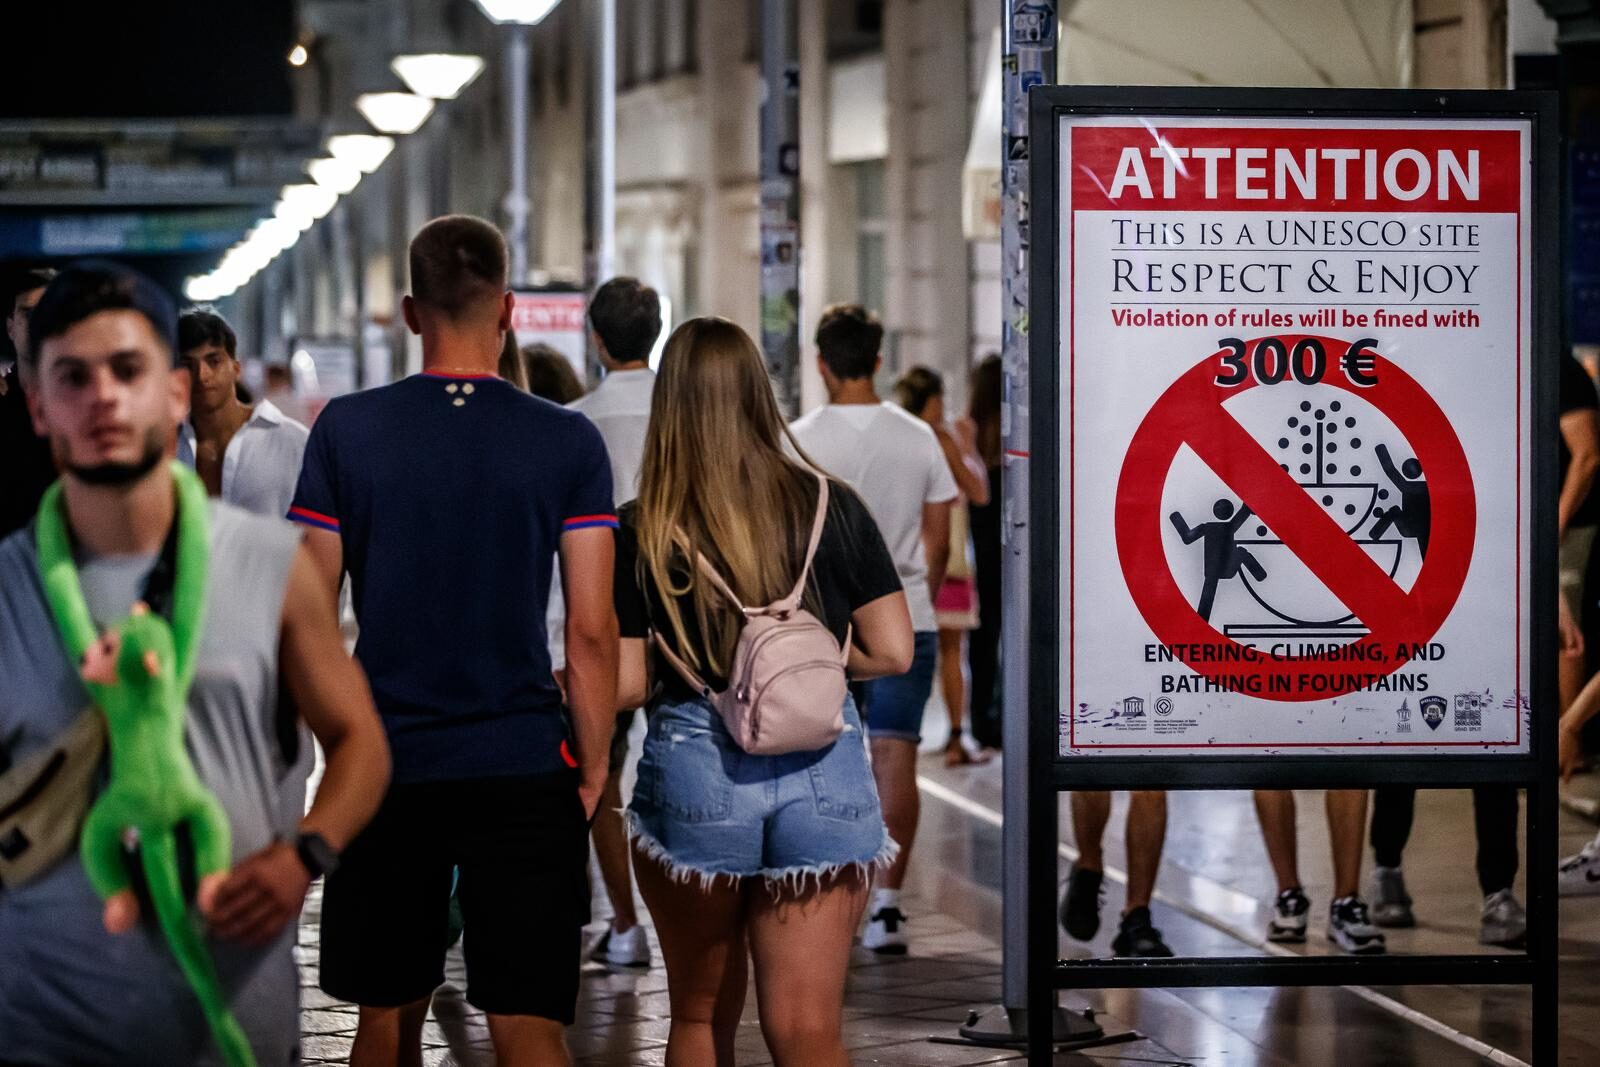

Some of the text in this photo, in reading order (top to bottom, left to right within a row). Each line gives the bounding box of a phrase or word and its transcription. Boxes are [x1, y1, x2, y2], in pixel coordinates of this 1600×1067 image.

[1108, 146, 1480, 201] ATTENTION
[1200, 222, 1223, 246] IS
[1234, 222, 1255, 246] A
[1266, 219, 1407, 247] UNESCO
[1419, 224, 1480, 247] SITE
[1111, 258, 1480, 302] RESPECT & ENJOY
[1111, 308, 1480, 328] Violation of rules will be fined with
[1214, 337, 1380, 387] 300 €
[1144, 643, 1446, 666] ENTERING, CLIMBING, AND
[1160, 673, 1430, 694] BATHING IN FOUNTAINS
